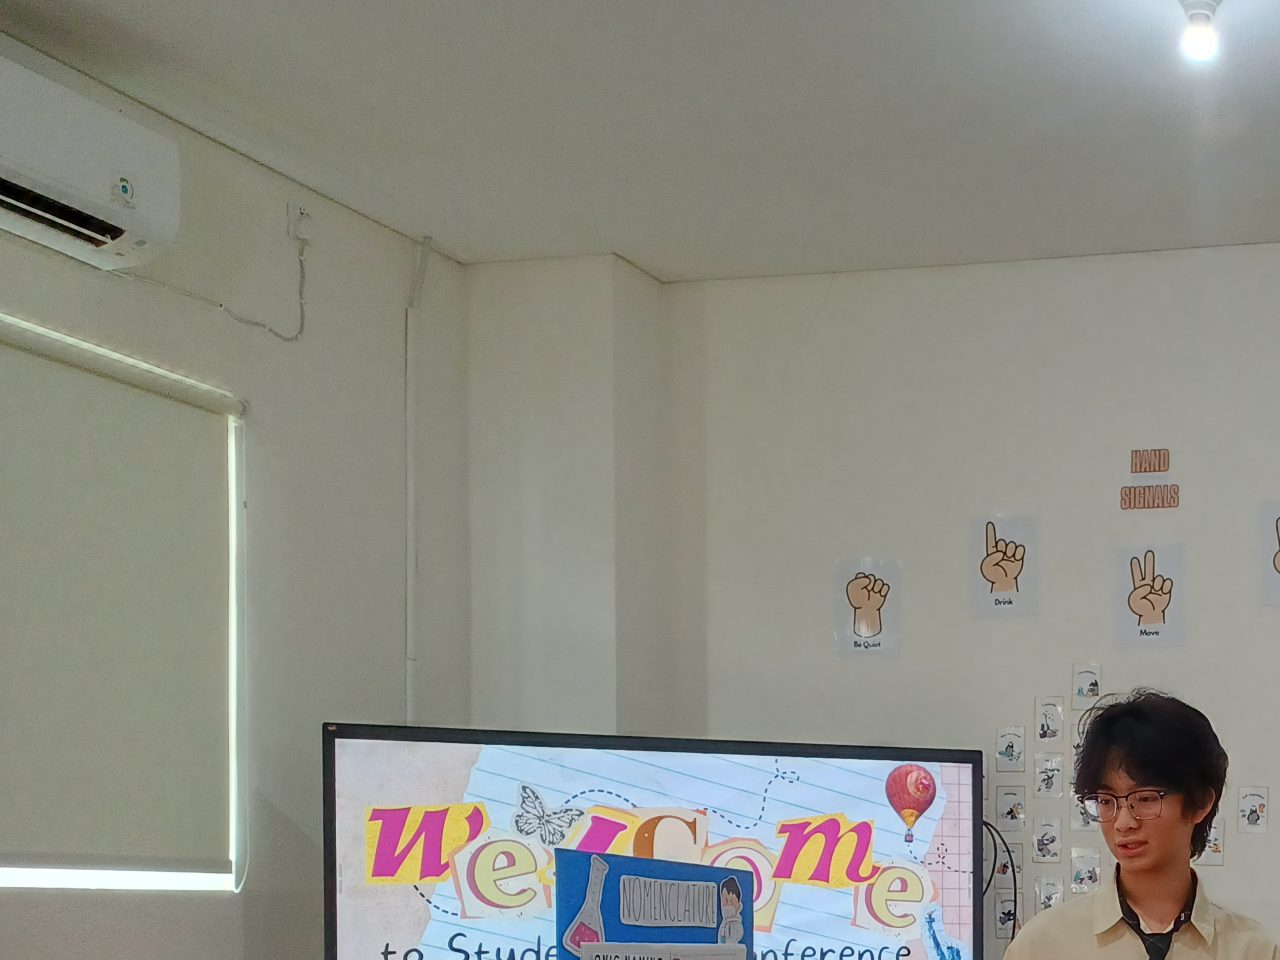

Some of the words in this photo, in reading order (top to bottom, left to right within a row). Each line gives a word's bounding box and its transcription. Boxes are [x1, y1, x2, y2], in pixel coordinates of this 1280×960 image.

[1131, 449, 1169, 473] HAND
[1121, 484, 1179, 510] SIGNALS
[994, 598, 1014, 606] Drink
[1139, 629, 1160, 637] Move
[622, 877, 717, 924] NOMENCLATURE
